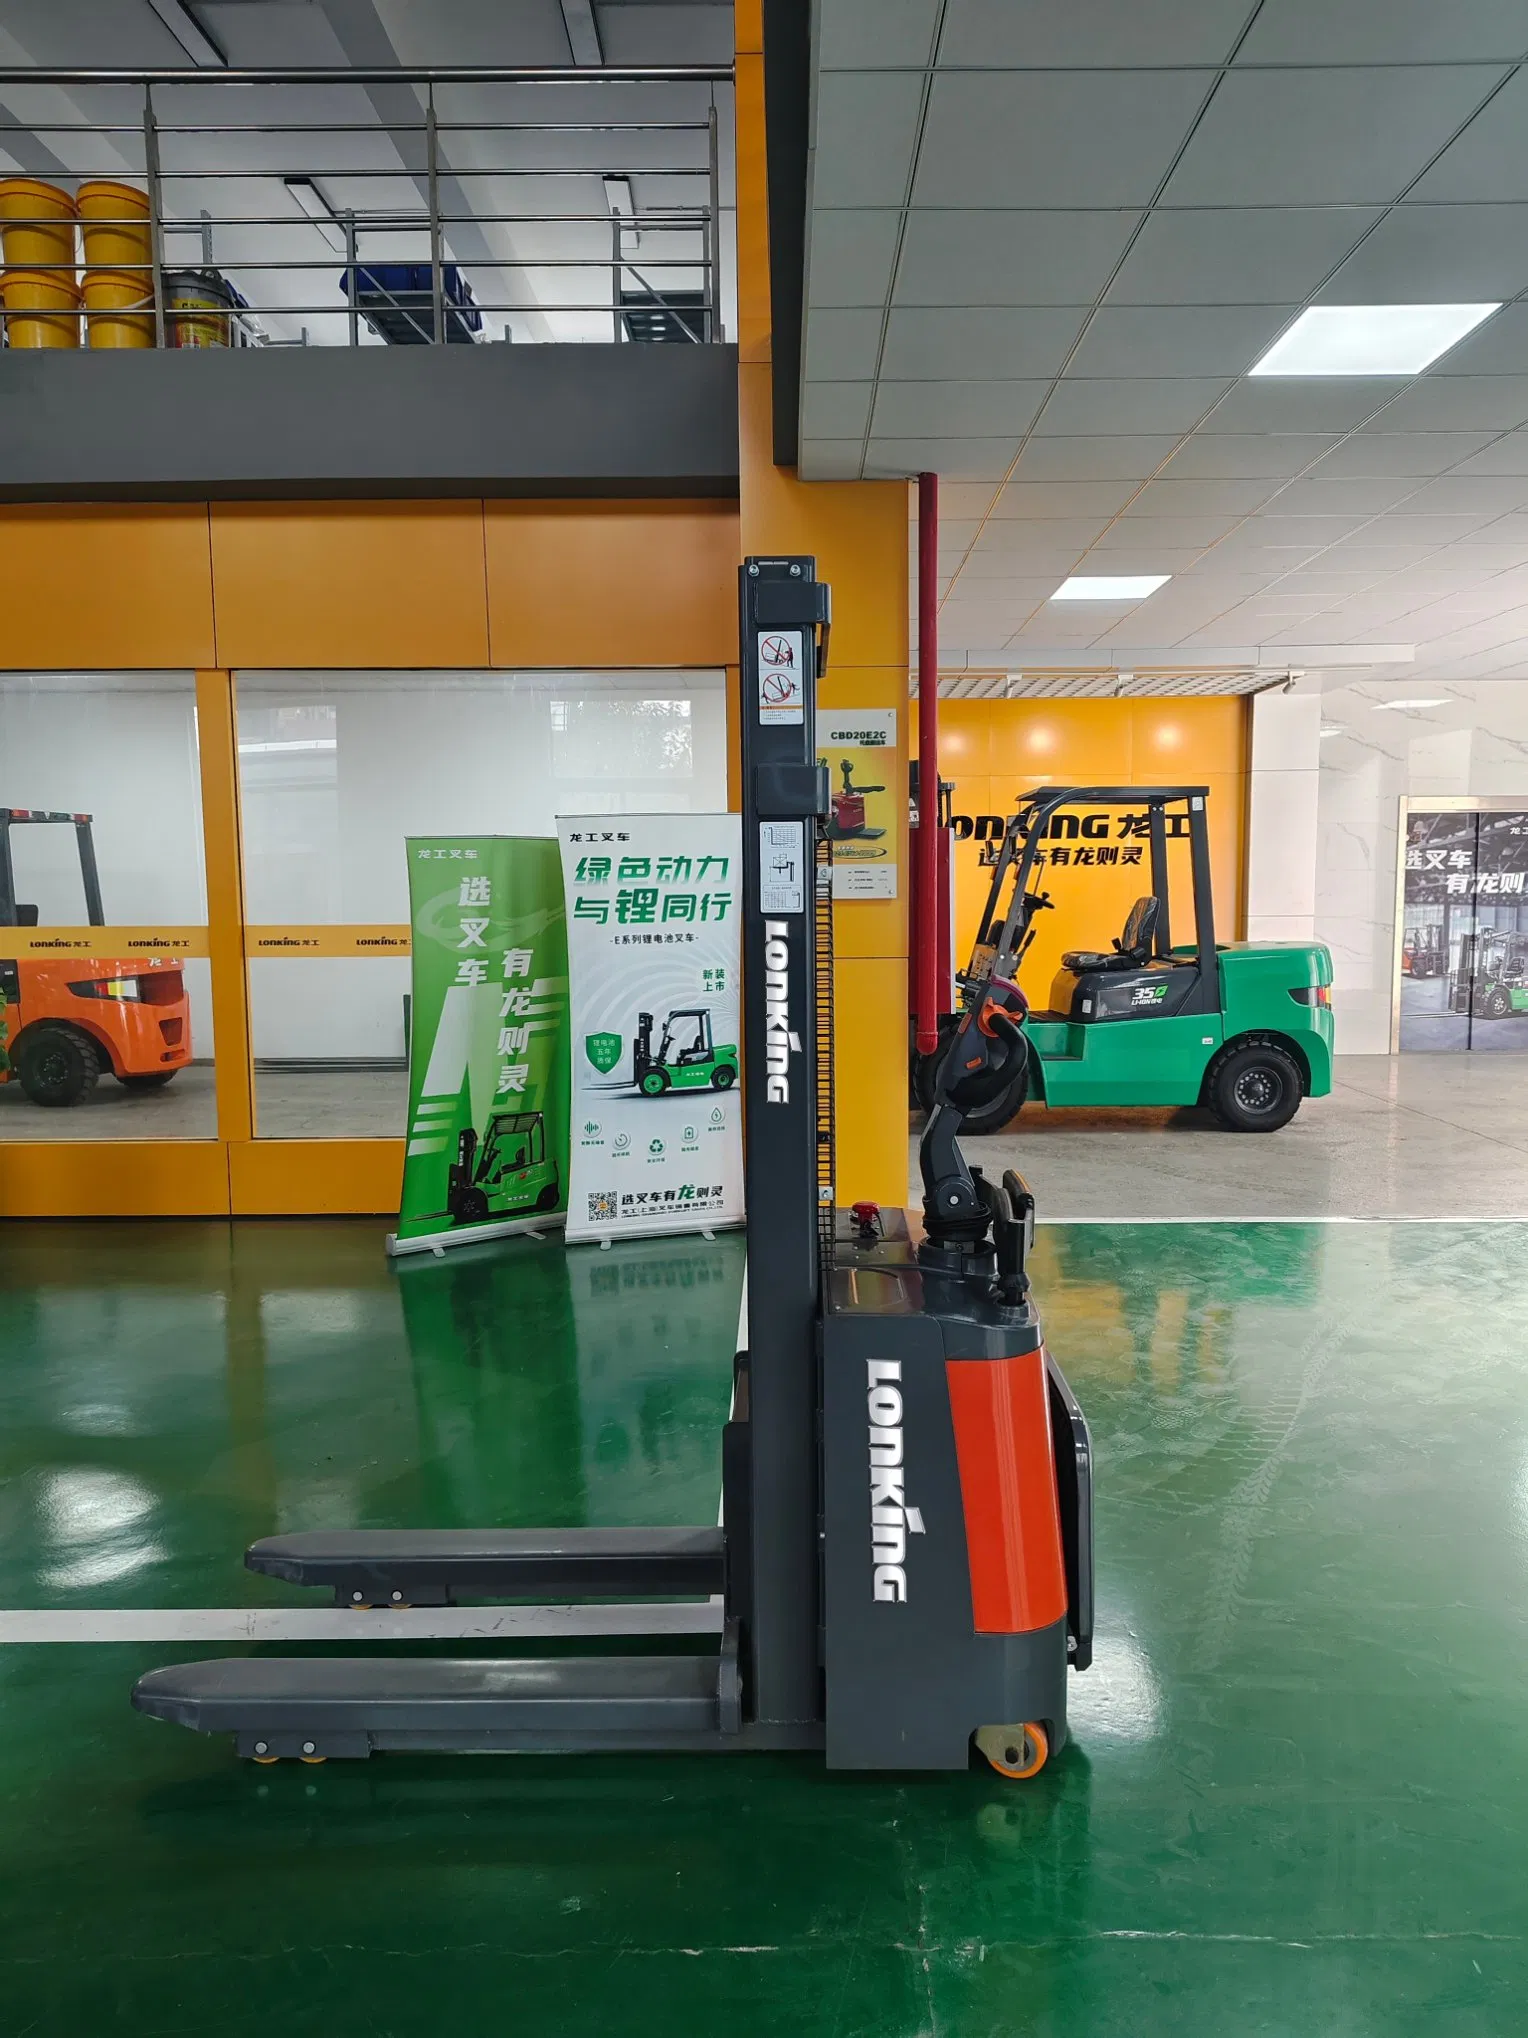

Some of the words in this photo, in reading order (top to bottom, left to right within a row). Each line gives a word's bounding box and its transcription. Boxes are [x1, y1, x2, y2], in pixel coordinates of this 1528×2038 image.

[830, 731, 887, 740] CBD20E2C
[570, 832, 631, 843] 龙工叉车
[418, 849, 479, 859] 龙工叉车
[573, 855, 730, 886] 绿色动力
[1445, 872, 1527, 894] 有龙则
[573, 888, 732, 925] 与锂同行
[454, 876, 491, 987] 选叉车
[73, 940, 92, 948] 龙工
[702, 981, 725, 992] 上市
[1132, 986, 1156, 1000] 35
[496, 948, 535, 1094] 有龙则灵
[597, 1048, 612, 1056] 五年
[621, 1184, 723, 1206] 选叉车有龙则灵
